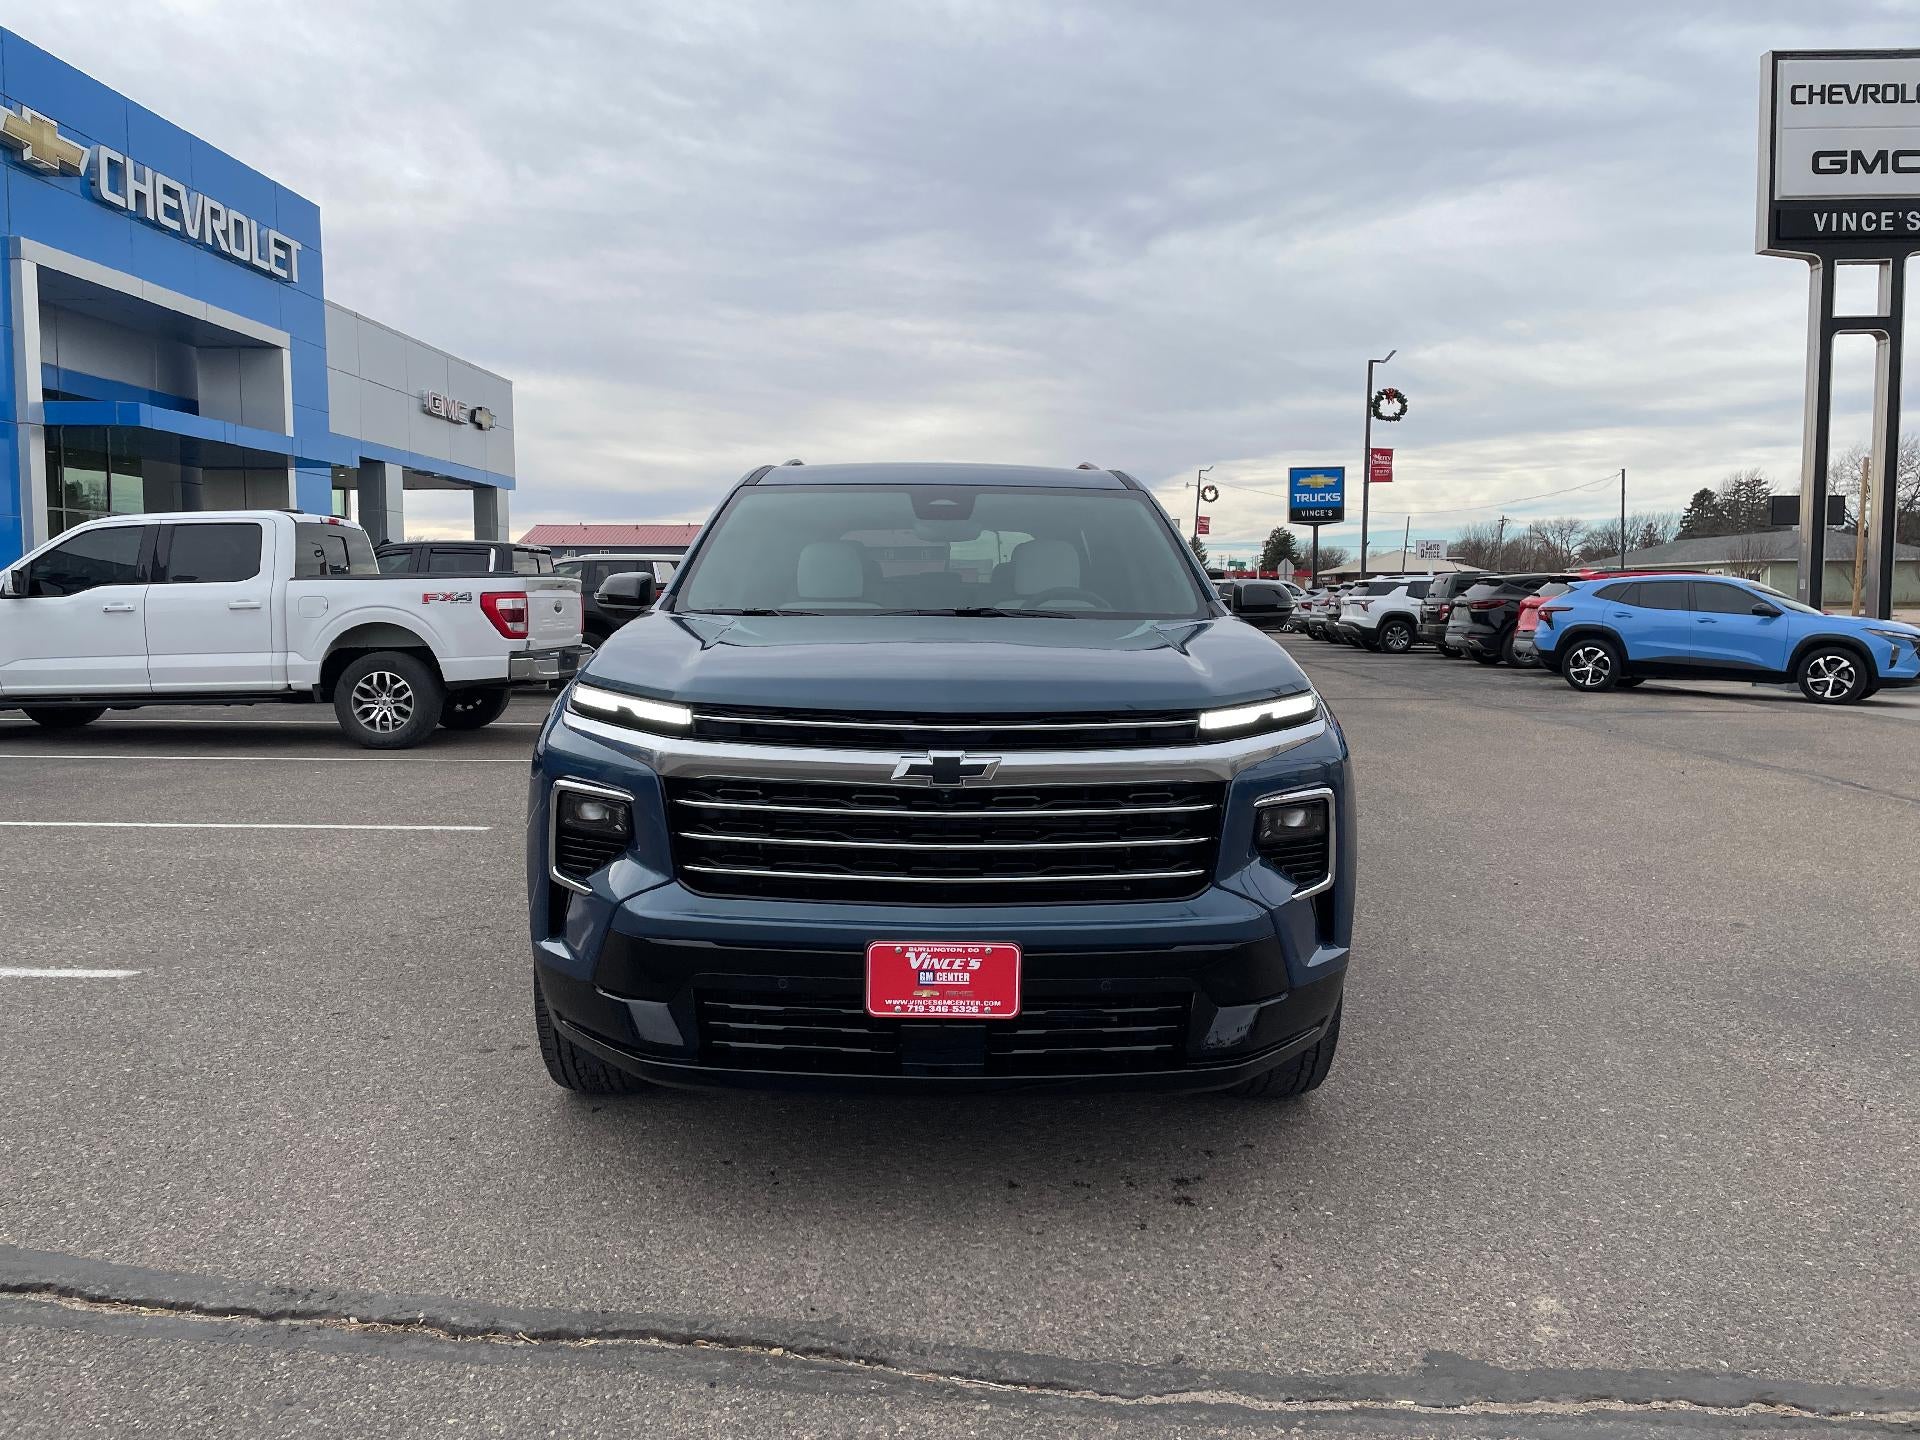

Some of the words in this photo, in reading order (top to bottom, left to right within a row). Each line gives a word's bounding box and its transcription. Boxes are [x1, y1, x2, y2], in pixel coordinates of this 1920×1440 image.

[1790, 83, 1920, 105] CHEVROL
[1811, 150, 1920, 175] GMC
[97, 144, 302, 284] CHEVROLET
[1813, 211, 1920, 232] VINCE'S
[425, 389, 469, 425] GMC
[1294, 492, 1341, 503] TRUCKS
[1301, 509, 1333, 517] VINCE'S
[422, 591, 472, 604] FX4
[908, 946, 966, 954] BURLINGTON,
[919, 971, 934, 982] GM
[936, 972, 970, 982] CENTER
[907, 1005, 979, 1013] 719-346-5326
